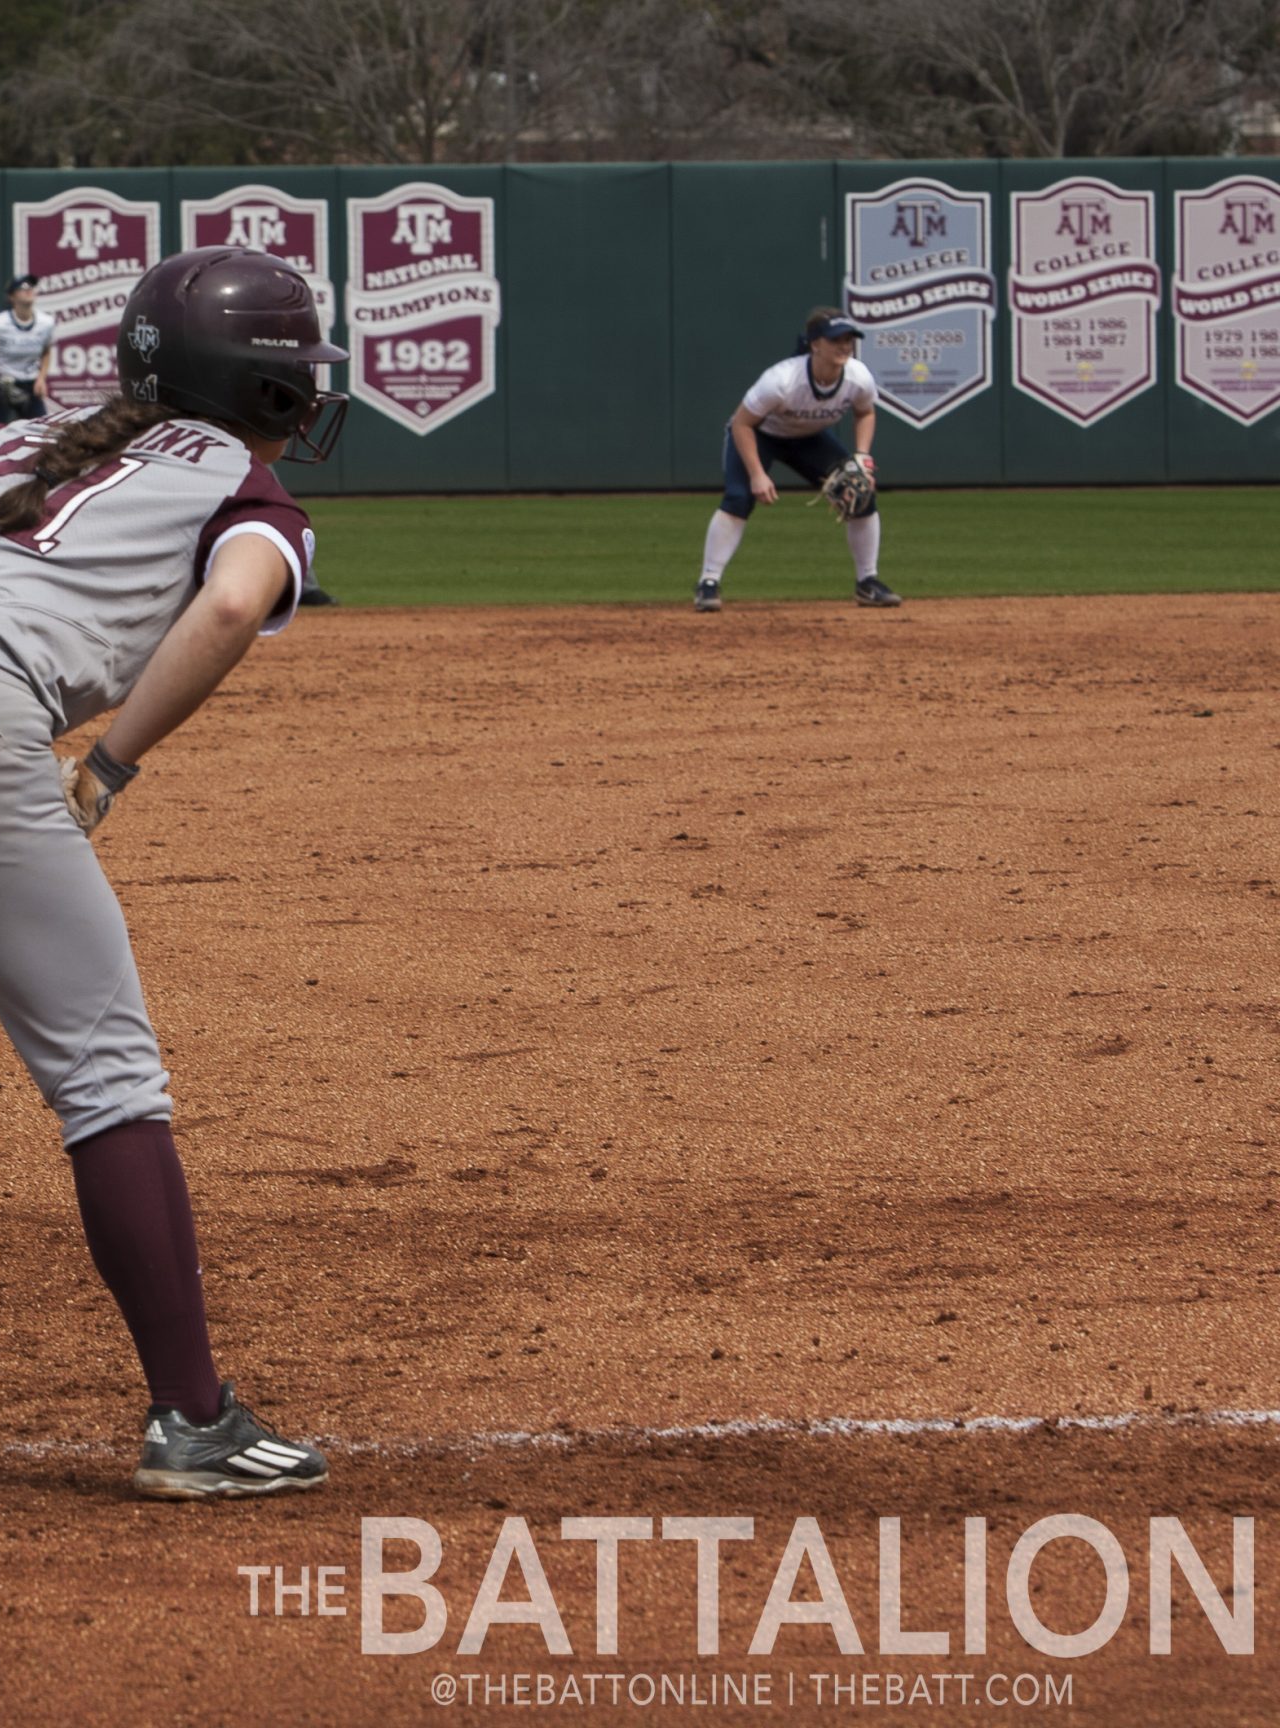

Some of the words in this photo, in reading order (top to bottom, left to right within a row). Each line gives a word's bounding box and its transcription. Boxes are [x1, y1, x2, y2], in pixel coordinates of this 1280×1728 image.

[366, 254, 479, 289] NATIONAL
[870, 249, 969, 282] COLLEGE
[1033, 241, 1131, 274] COLLEGE
[1197, 250, 1280, 280] COLLEG
[354, 287, 493, 323] CHAMPIONS
[851, 293, 922, 318] WORLD
[922, 281, 991, 304] SERIES
[1016, 284, 1087, 308] WORLD
[1087, 271, 1156, 296] SERIES
[1179, 291, 1250, 315] WORLD
[54, 294, 127, 324] AMPIO
[1251, 328, 1280, 343] 198
[48, 345, 120, 376] 198
[374, 340, 472, 373] 1982
[1251, 345, 1280, 360] 198
[131, 421, 230, 465] INK
